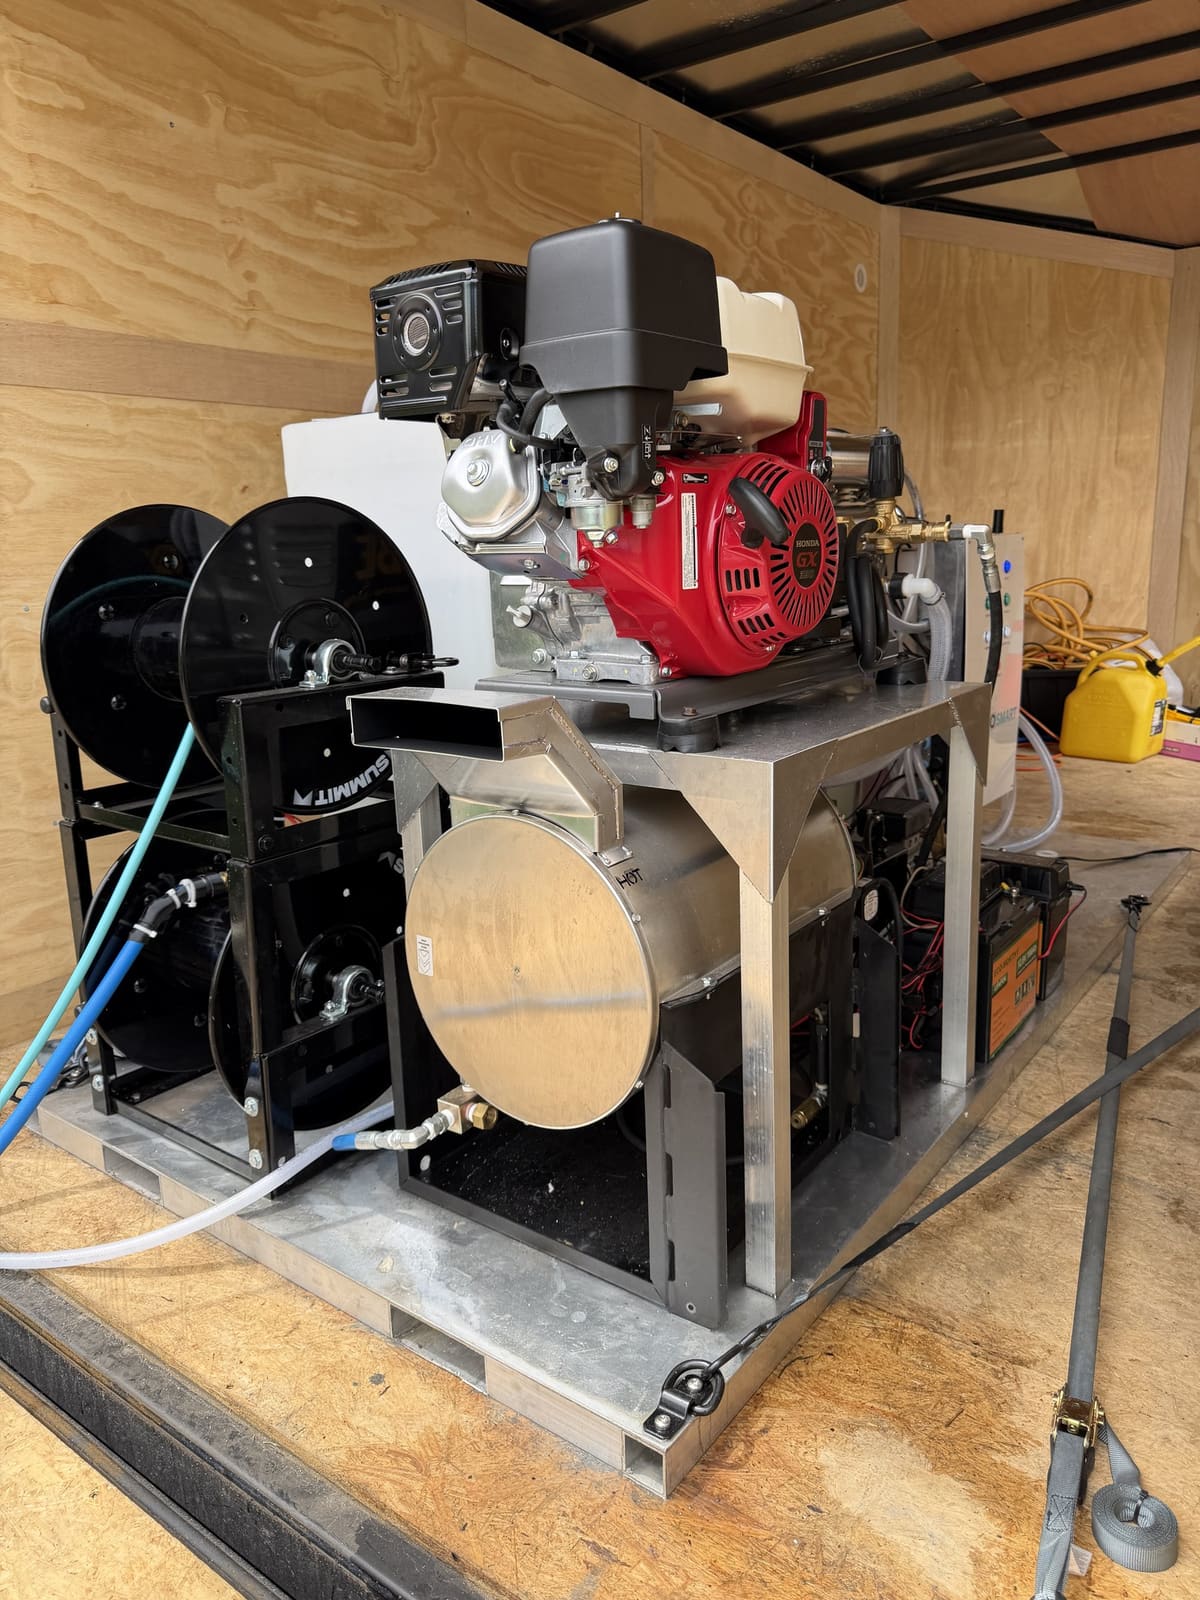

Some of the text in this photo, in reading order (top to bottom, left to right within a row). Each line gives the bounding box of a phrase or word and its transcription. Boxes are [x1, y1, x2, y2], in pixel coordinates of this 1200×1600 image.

[796, 539, 820, 548] HONDA
[796, 551, 818, 567] GX
[314, 754, 390, 806] SUMMIT
[615, 868, 643, 889] HOT
